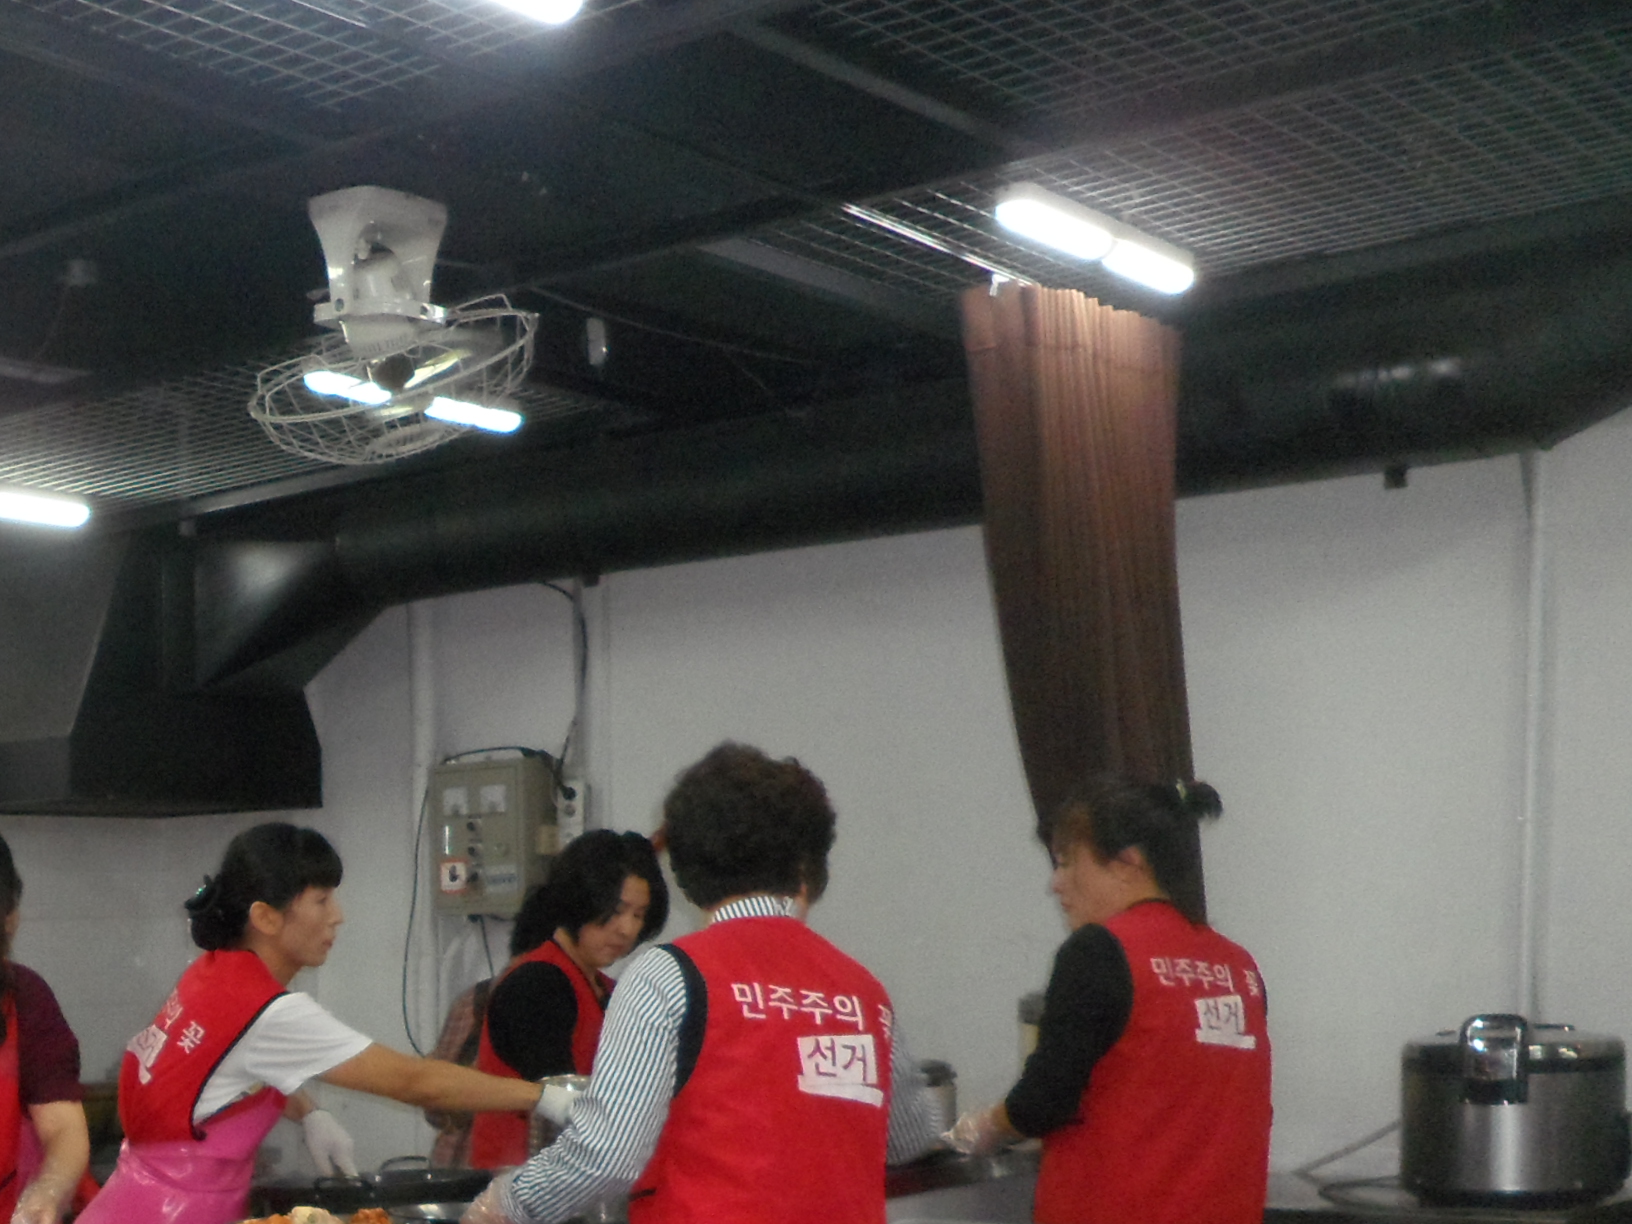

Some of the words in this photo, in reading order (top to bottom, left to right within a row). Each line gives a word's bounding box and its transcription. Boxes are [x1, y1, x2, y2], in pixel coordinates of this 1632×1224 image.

[1149, 957, 1234, 992] 민주주의
[730, 981, 864, 1032] 민주주의
[1203, 999, 1241, 1035] 선거
[176, 1020, 206, 1054] 꽃
[806, 1036, 869, 1084] 선거
